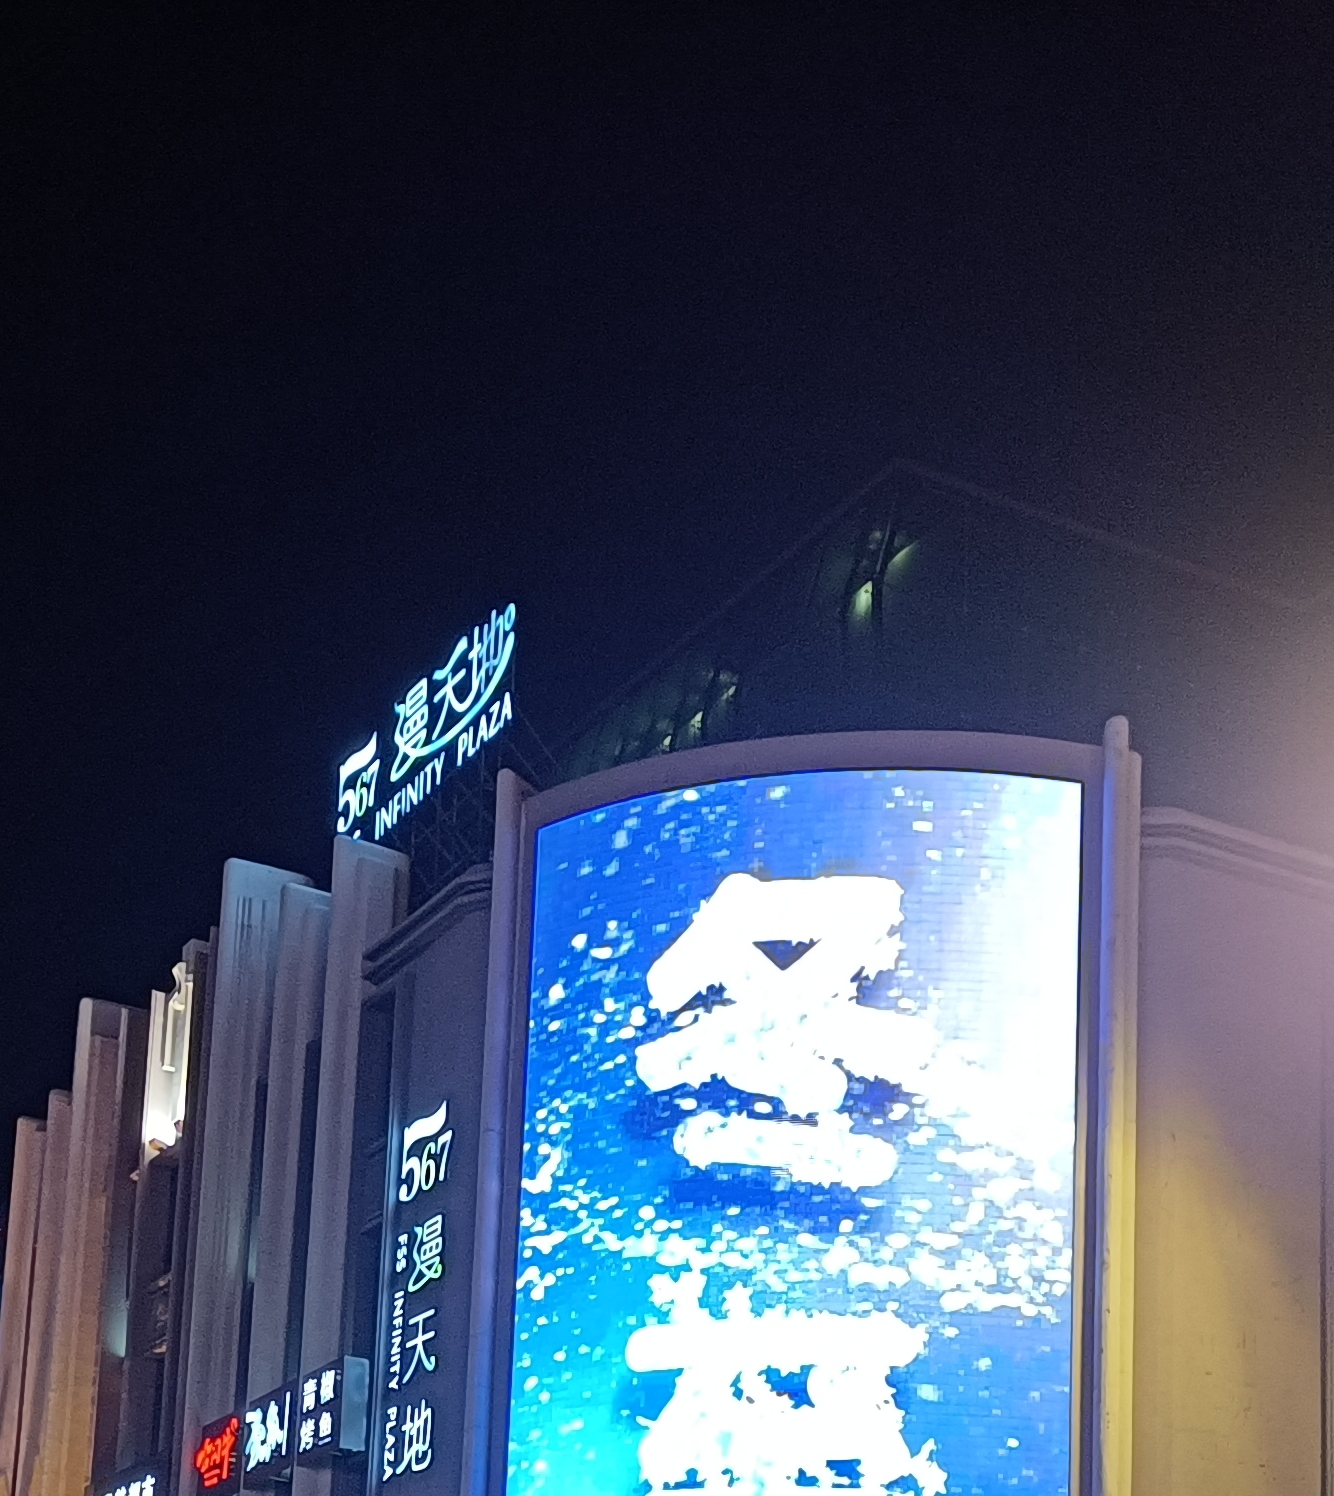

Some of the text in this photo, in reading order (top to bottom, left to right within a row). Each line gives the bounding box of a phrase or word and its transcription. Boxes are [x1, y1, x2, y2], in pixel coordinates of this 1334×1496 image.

[374, 691, 513, 840] INFINITY PLAZA
[398, 1100, 453, 1202] 567
[386, 1290, 405, 1391] INFINITY
[395, 1214, 443, 1475] 漫天地
[382, 1405, 398, 1482] PLAZA
